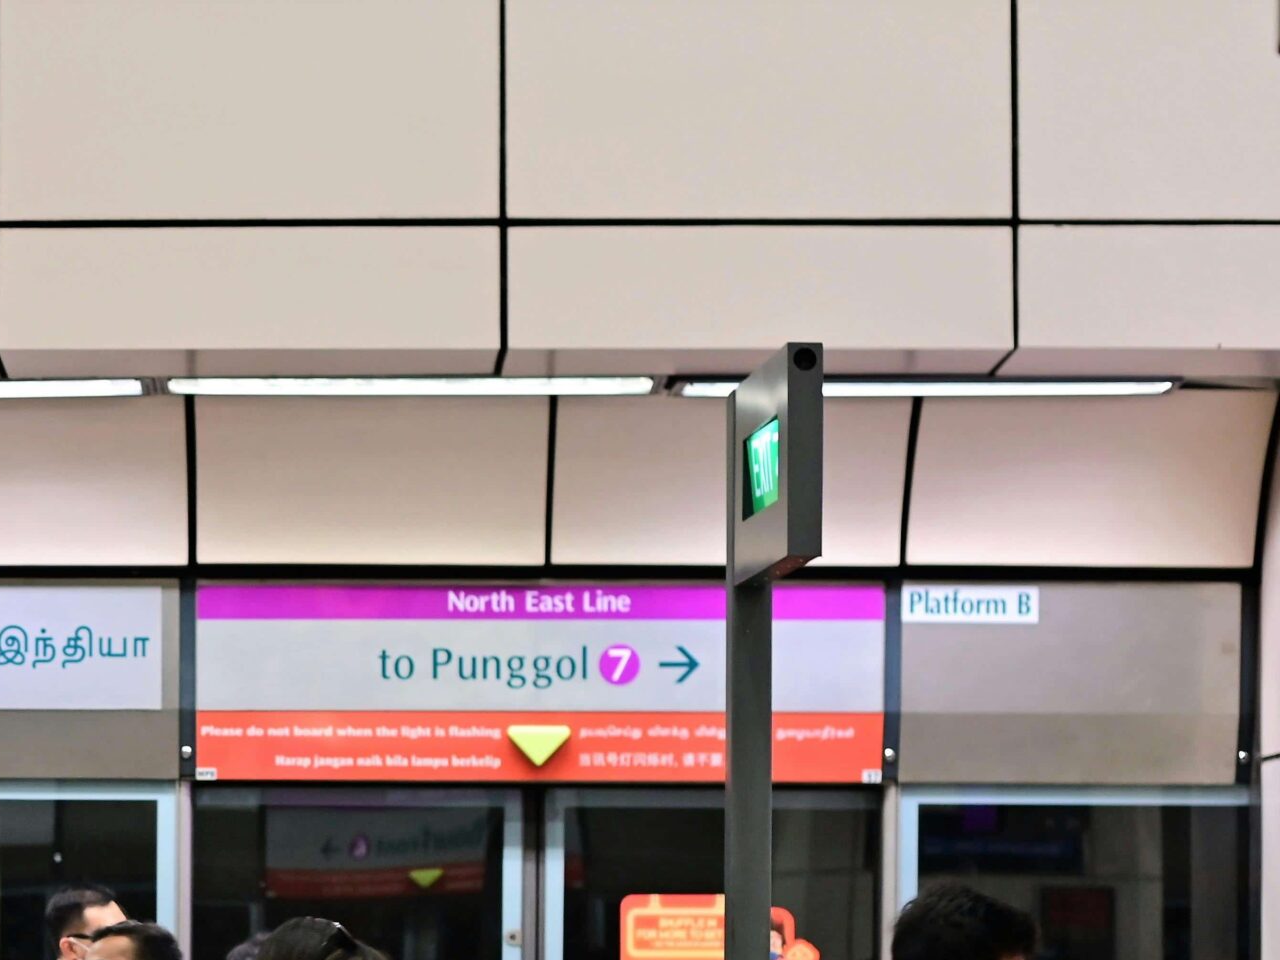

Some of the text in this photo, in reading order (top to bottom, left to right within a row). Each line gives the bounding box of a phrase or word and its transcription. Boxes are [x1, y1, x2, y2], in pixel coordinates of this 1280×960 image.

[448, 590, 632, 613] North East Line
[909, 590, 1031, 615] Platform B
[379, 646, 632, 689] to Punggol 7
[200, 725, 243, 737] Please
[246, 725, 264, 737] do
[376, 725, 398, 737] the
[434, 725, 446, 737] is
[448, 725, 501, 739] flashing
